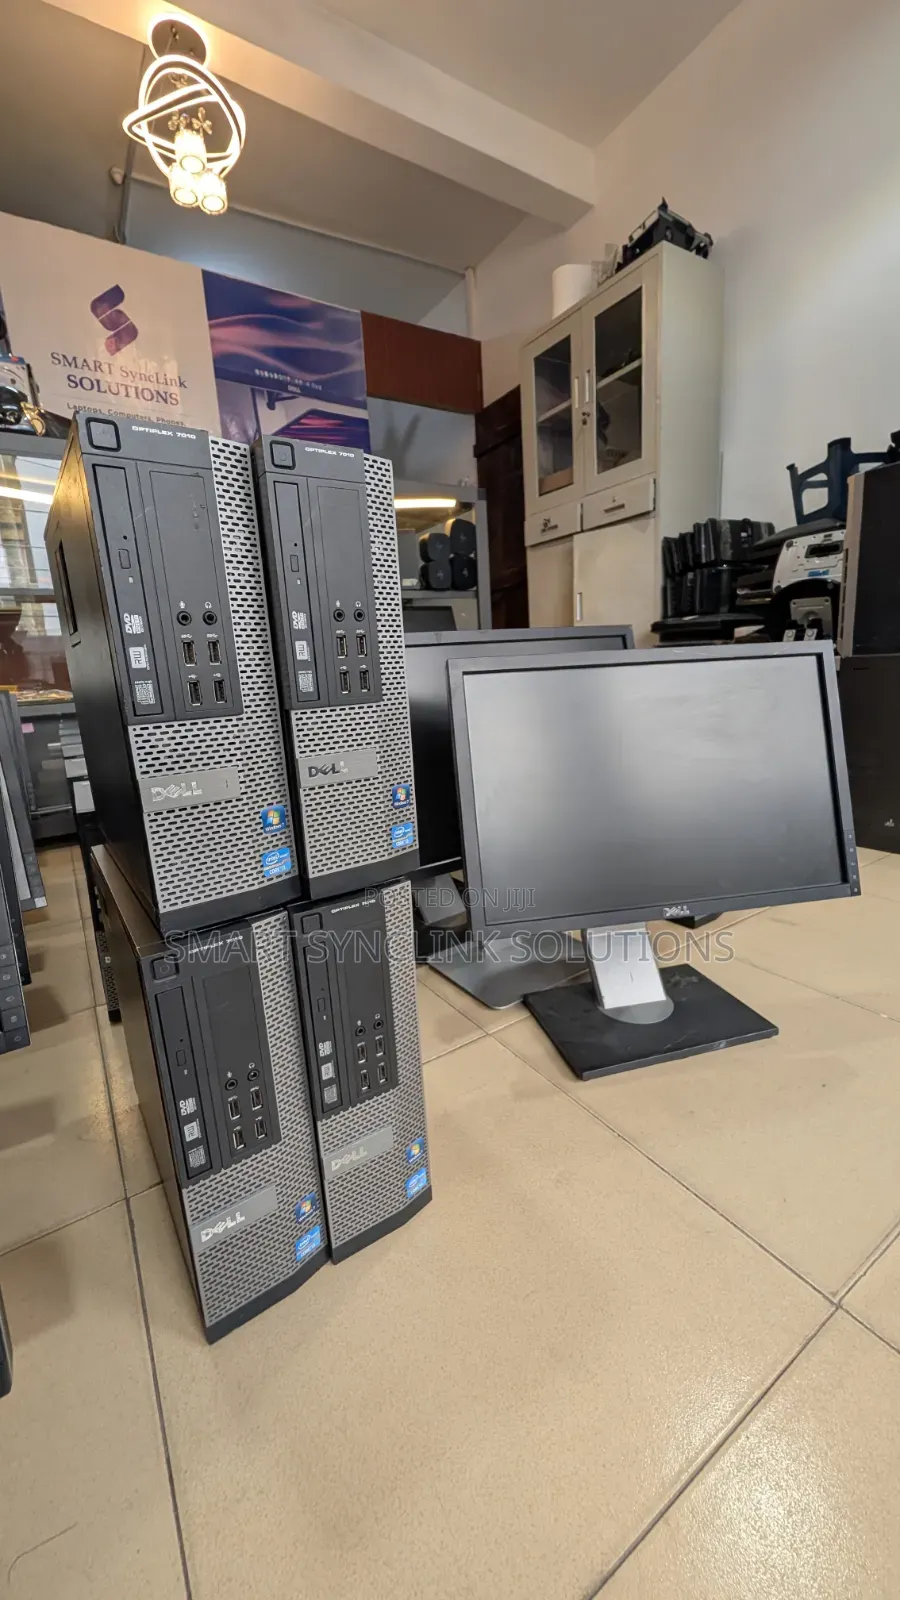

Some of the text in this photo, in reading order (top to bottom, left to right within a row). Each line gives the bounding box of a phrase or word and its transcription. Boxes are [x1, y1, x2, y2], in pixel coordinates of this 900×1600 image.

[50, 351, 188, 389] SMART SyncLink
[66, 374, 180, 406] SOLUTIONS
[131, 425, 197, 440] OPTIPLEX 7010
[304, 446, 337, 456] OPTIPLEX
[124, 612, 133, 634] DVD
[307, 760, 349, 779] DELL
[150, 781, 203, 802] DELL
[331, 1146, 368, 1171] DELL
[200, 1211, 246, 1243] DELL
